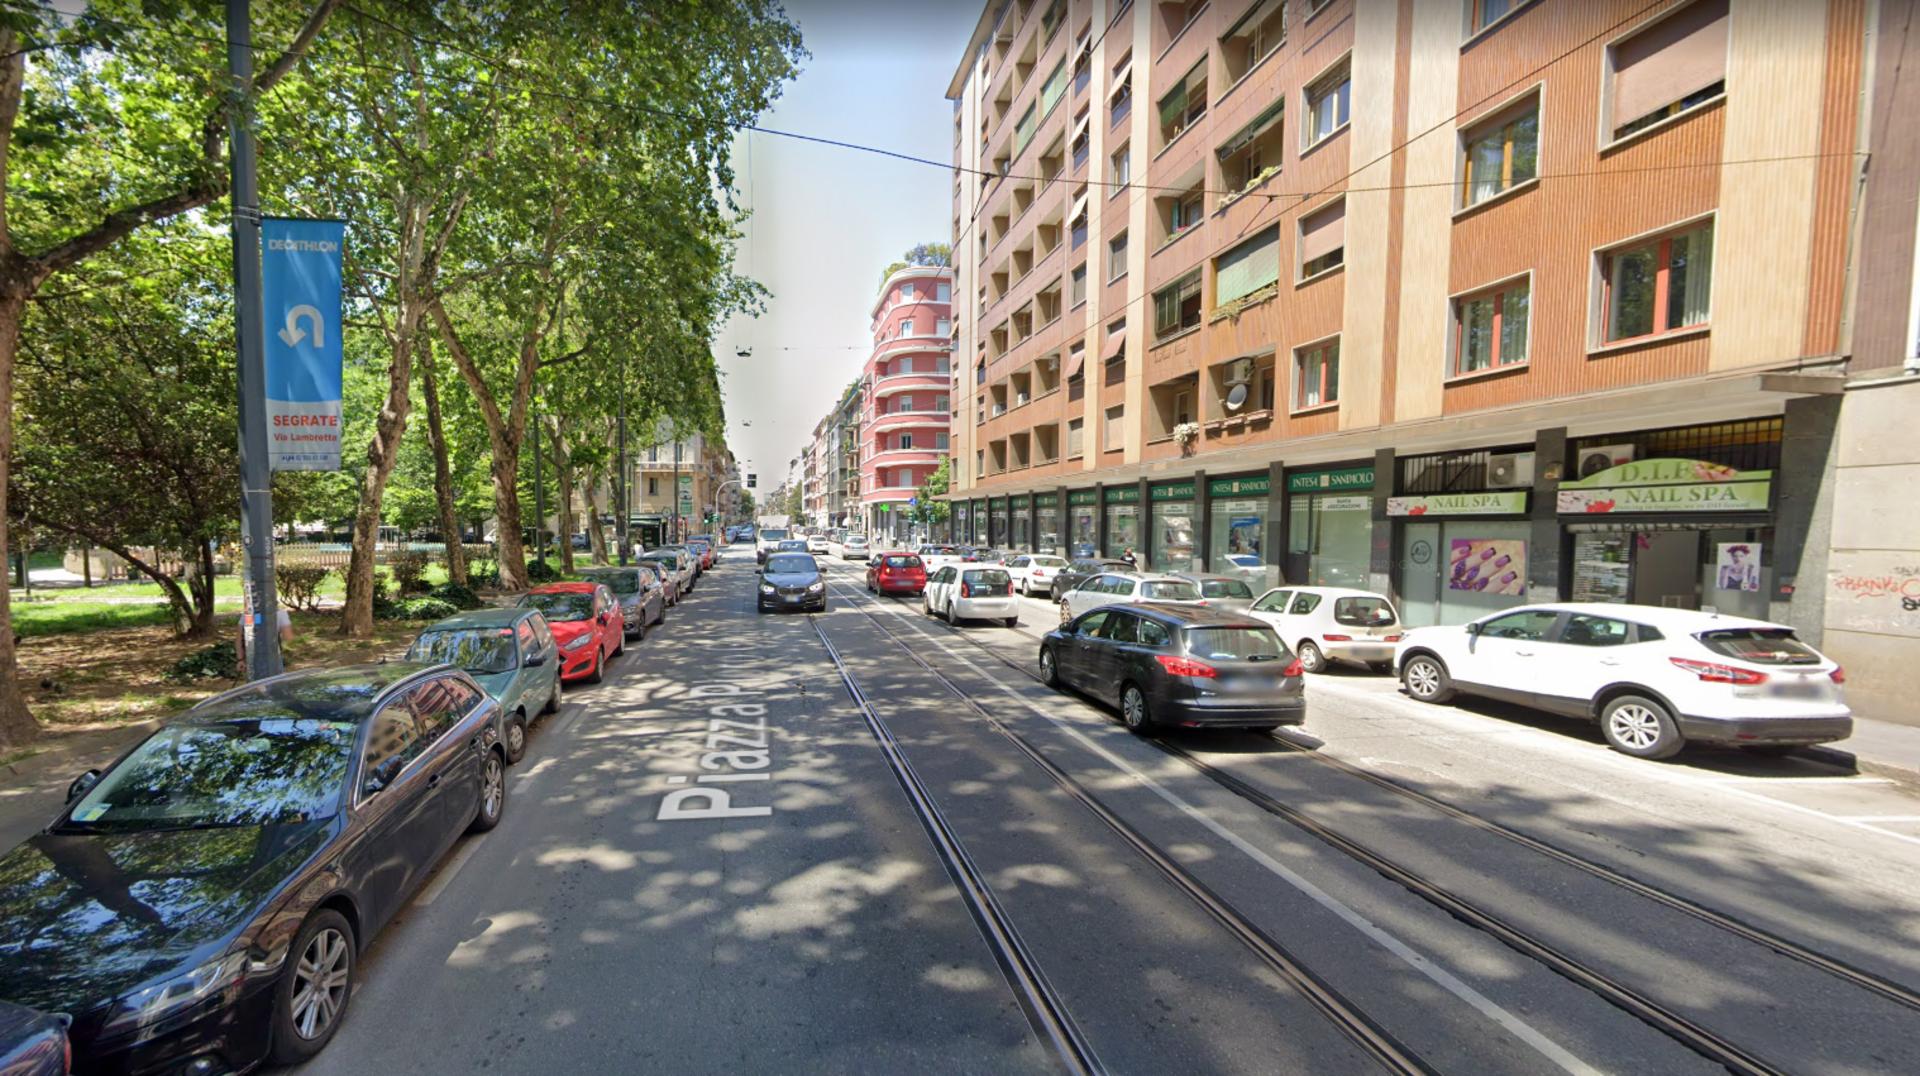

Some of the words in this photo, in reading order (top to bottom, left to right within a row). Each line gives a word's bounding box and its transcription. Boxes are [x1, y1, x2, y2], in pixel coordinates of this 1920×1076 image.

[268, 239, 338, 252] DECATHLON
[273, 415, 337, 427] SEGRATE
[274, 433, 288, 442] Via
[1292, 477, 1318, 488] INTESA
[1331, 472, 1374, 485] SANPAOLO
[1434, 496, 1467, 508] NAIL
[1472, 494, 1501, 507] SPA
[1625, 487, 1682, 504] NAIL
[1689, 485, 1737, 501] SPA
